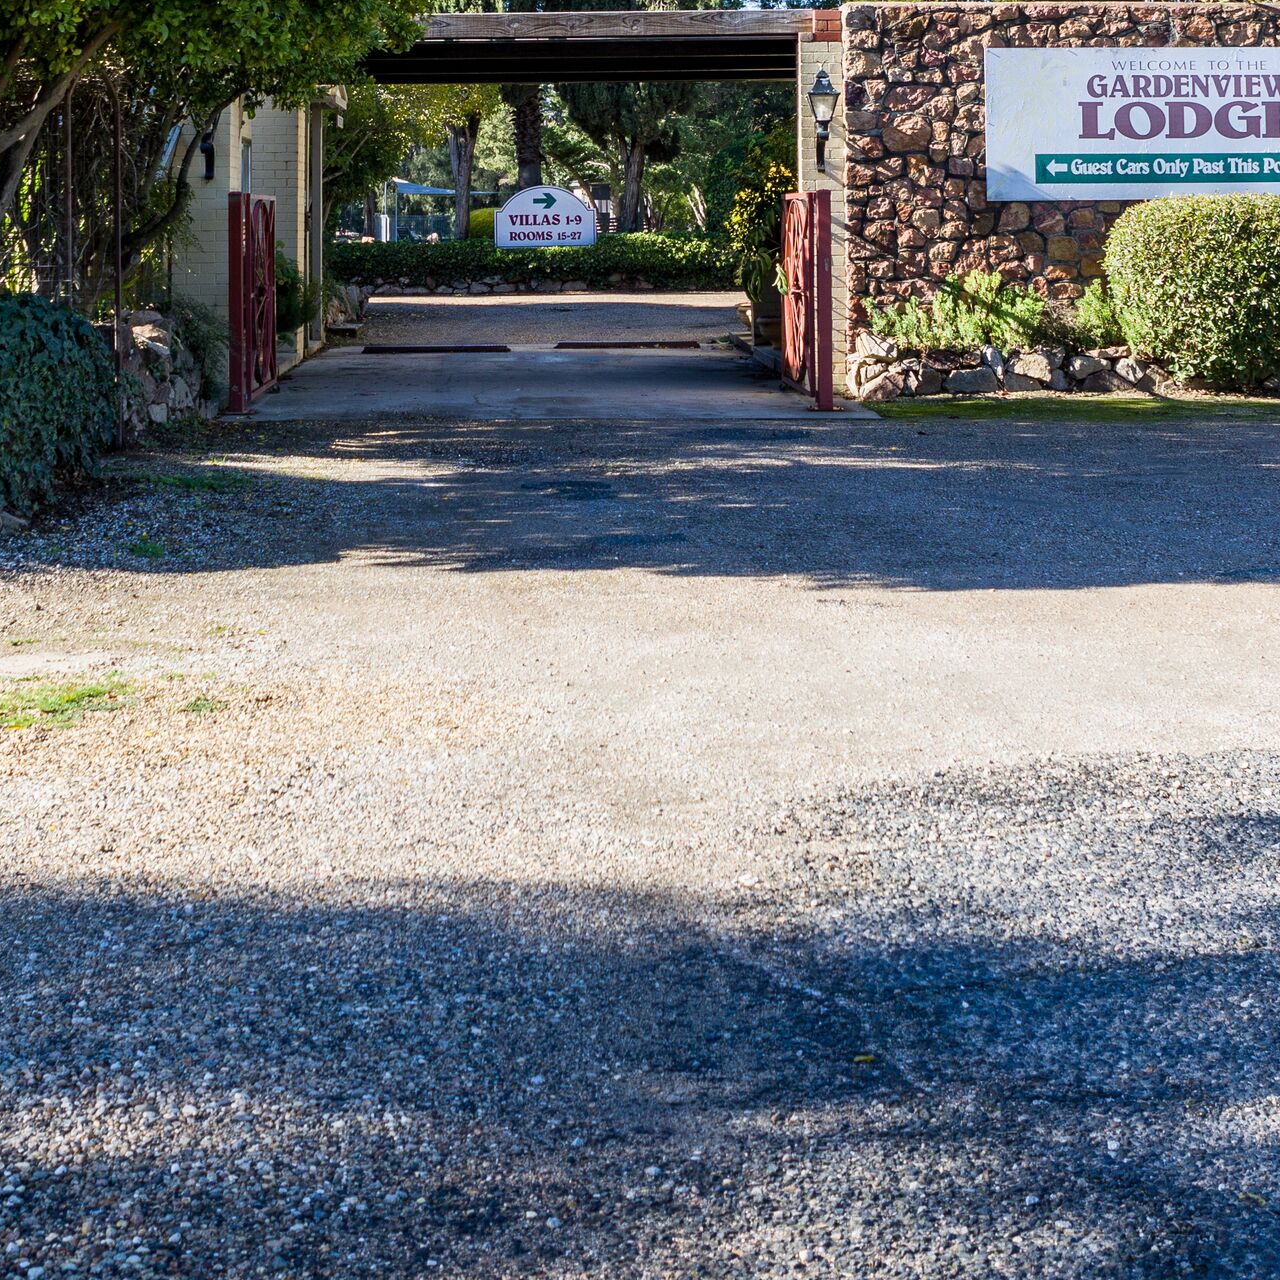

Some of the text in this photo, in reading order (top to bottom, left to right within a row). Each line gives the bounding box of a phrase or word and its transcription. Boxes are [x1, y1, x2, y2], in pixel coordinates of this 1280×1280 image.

[1111, 60, 1268, 71] WELCOME TO THE
[1071, 158, 1113, 175] Guest
[1116, 158, 1150, 175] Cars
[1153, 158, 1190, 177] Only
[1192, 158, 1225, 174] Past
[1227, 157, 1260, 174] This
[508, 214, 582, 226] VILLAS 1-9
[509, 231, 582, 241] ROOMS 15-27
